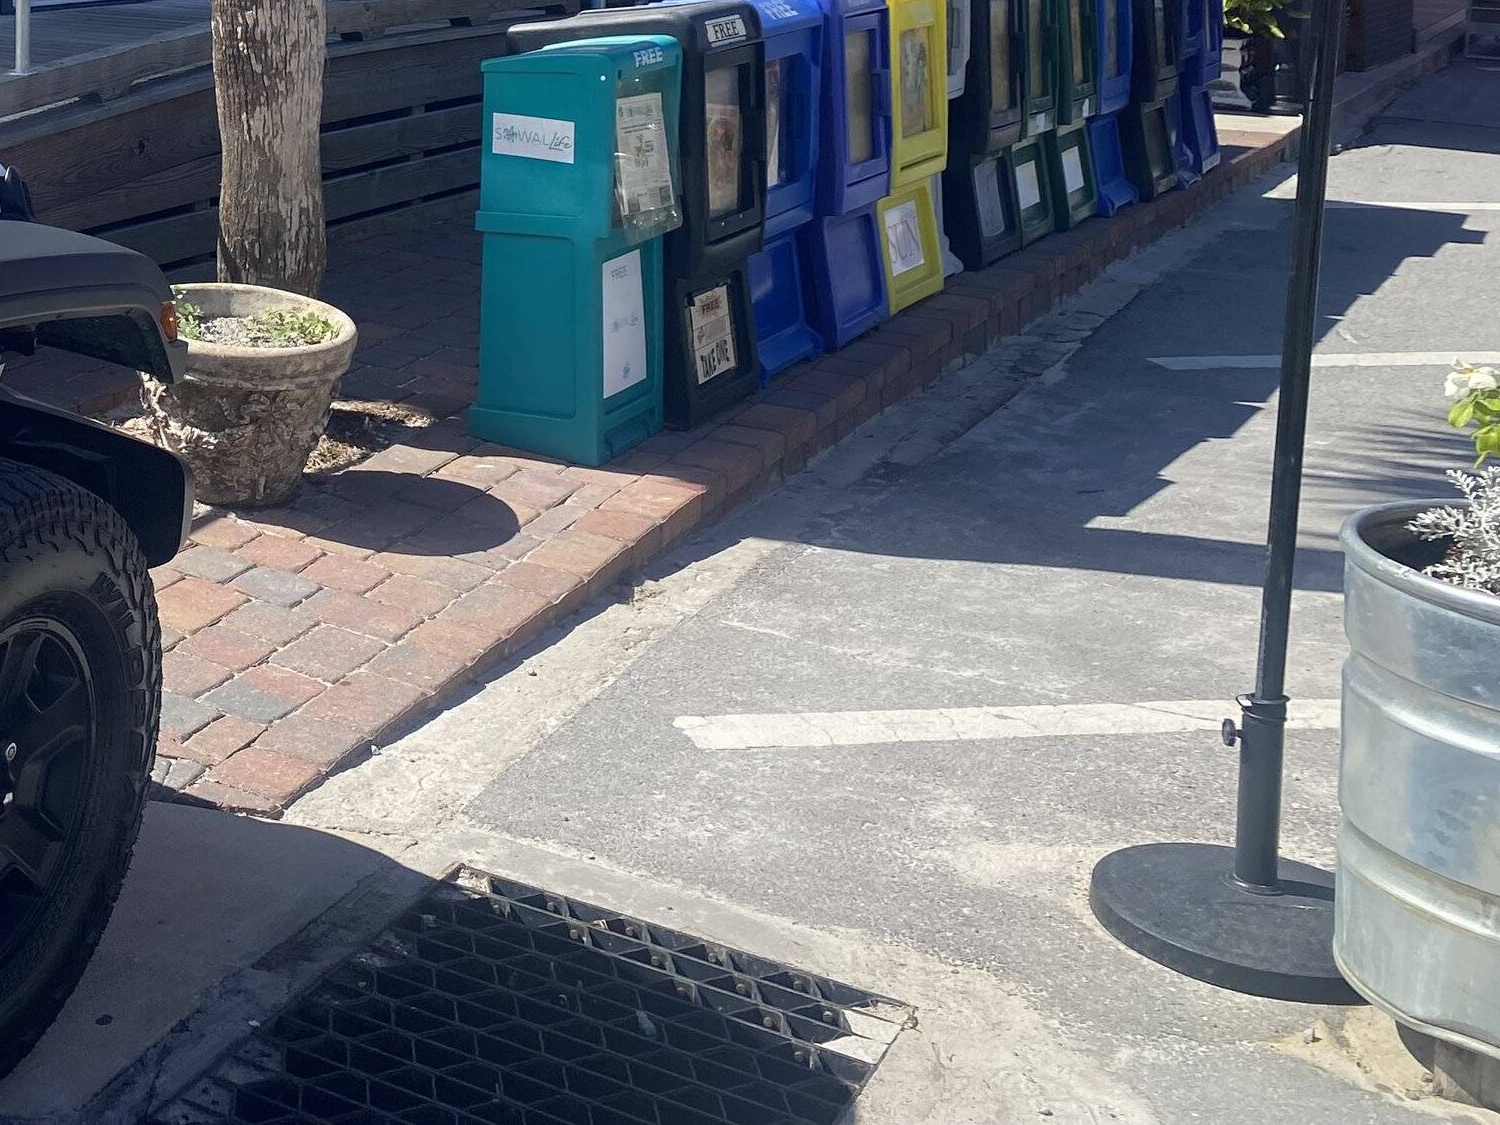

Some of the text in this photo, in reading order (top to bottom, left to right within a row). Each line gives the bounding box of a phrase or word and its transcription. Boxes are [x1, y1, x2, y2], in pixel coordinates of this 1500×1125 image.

[712, 20, 740, 40] FREE
[634, 46, 664, 68] FREE
[887, 216, 920, 264] SUN
[701, 298, 721, 315] FREE
[700, 338, 730, 378] TAKE ONE
